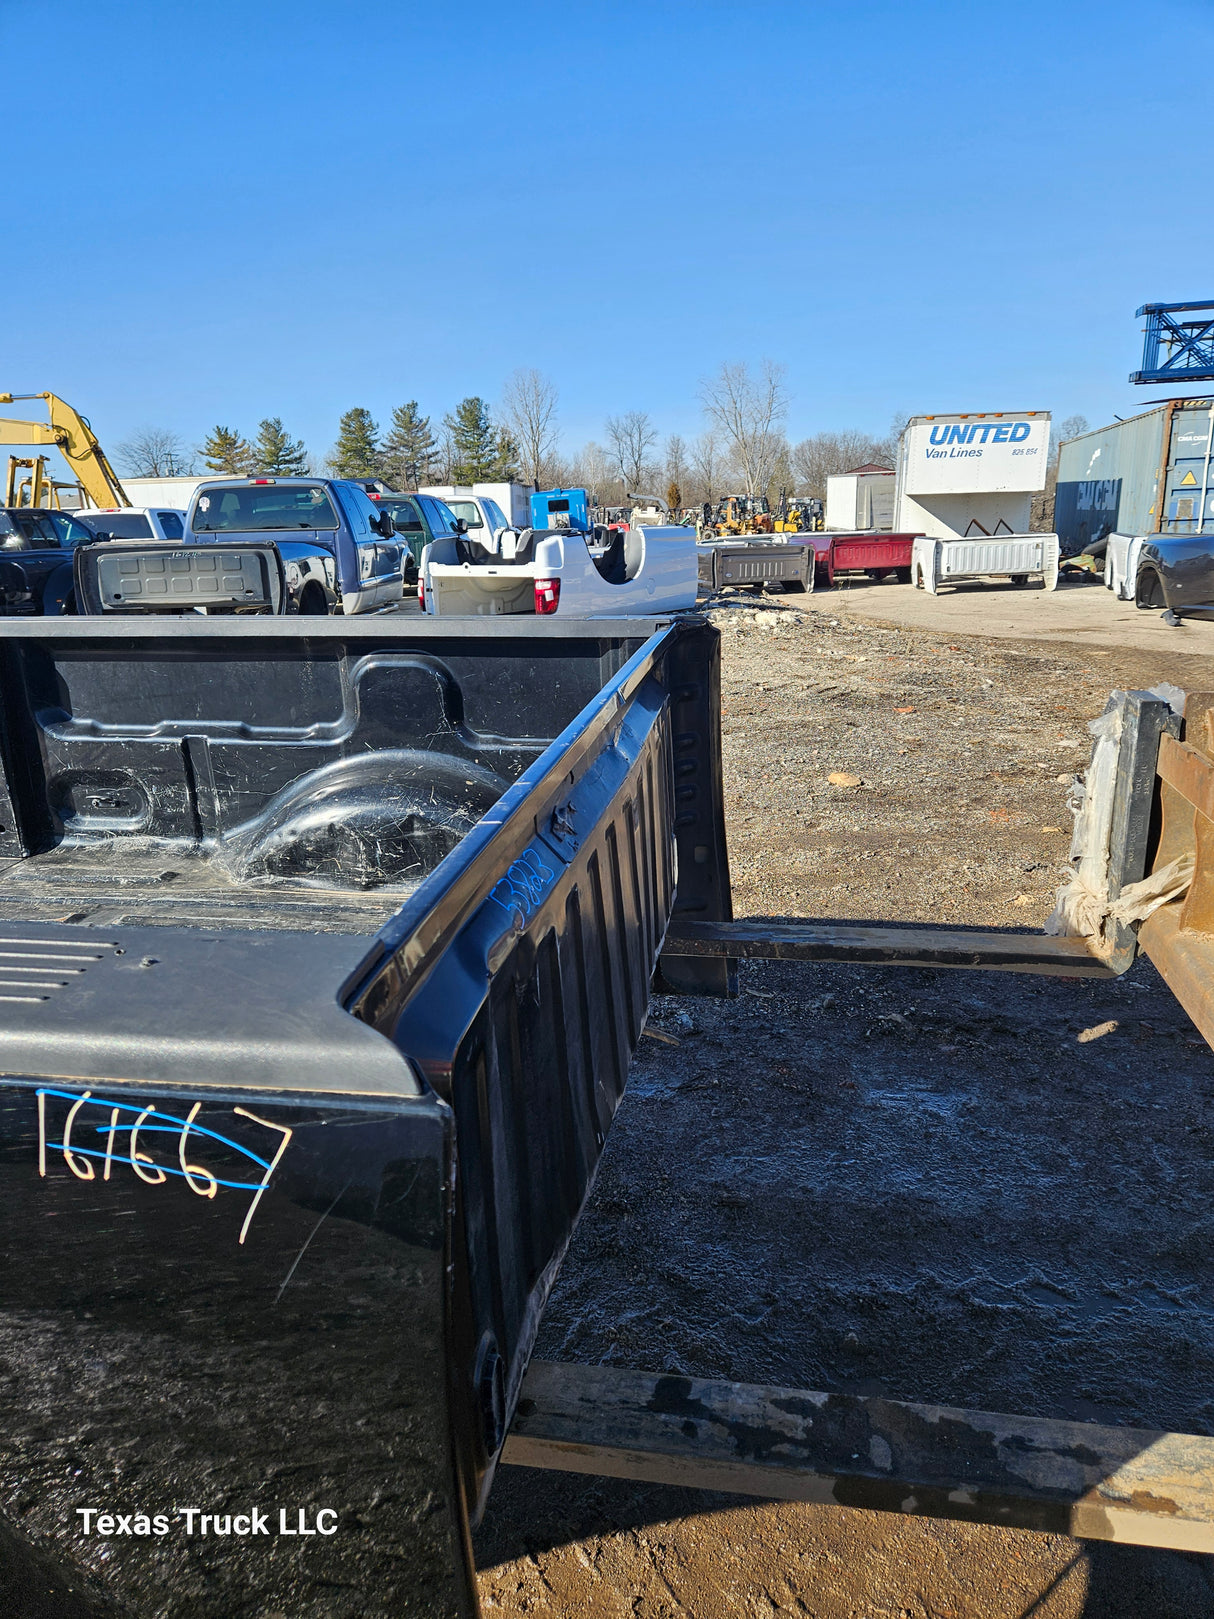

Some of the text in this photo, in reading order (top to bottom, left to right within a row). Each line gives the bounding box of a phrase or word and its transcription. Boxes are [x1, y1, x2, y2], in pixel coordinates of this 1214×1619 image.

[929, 422, 1032, 446] UNITED
[925, 447, 983, 459] Van Lines
